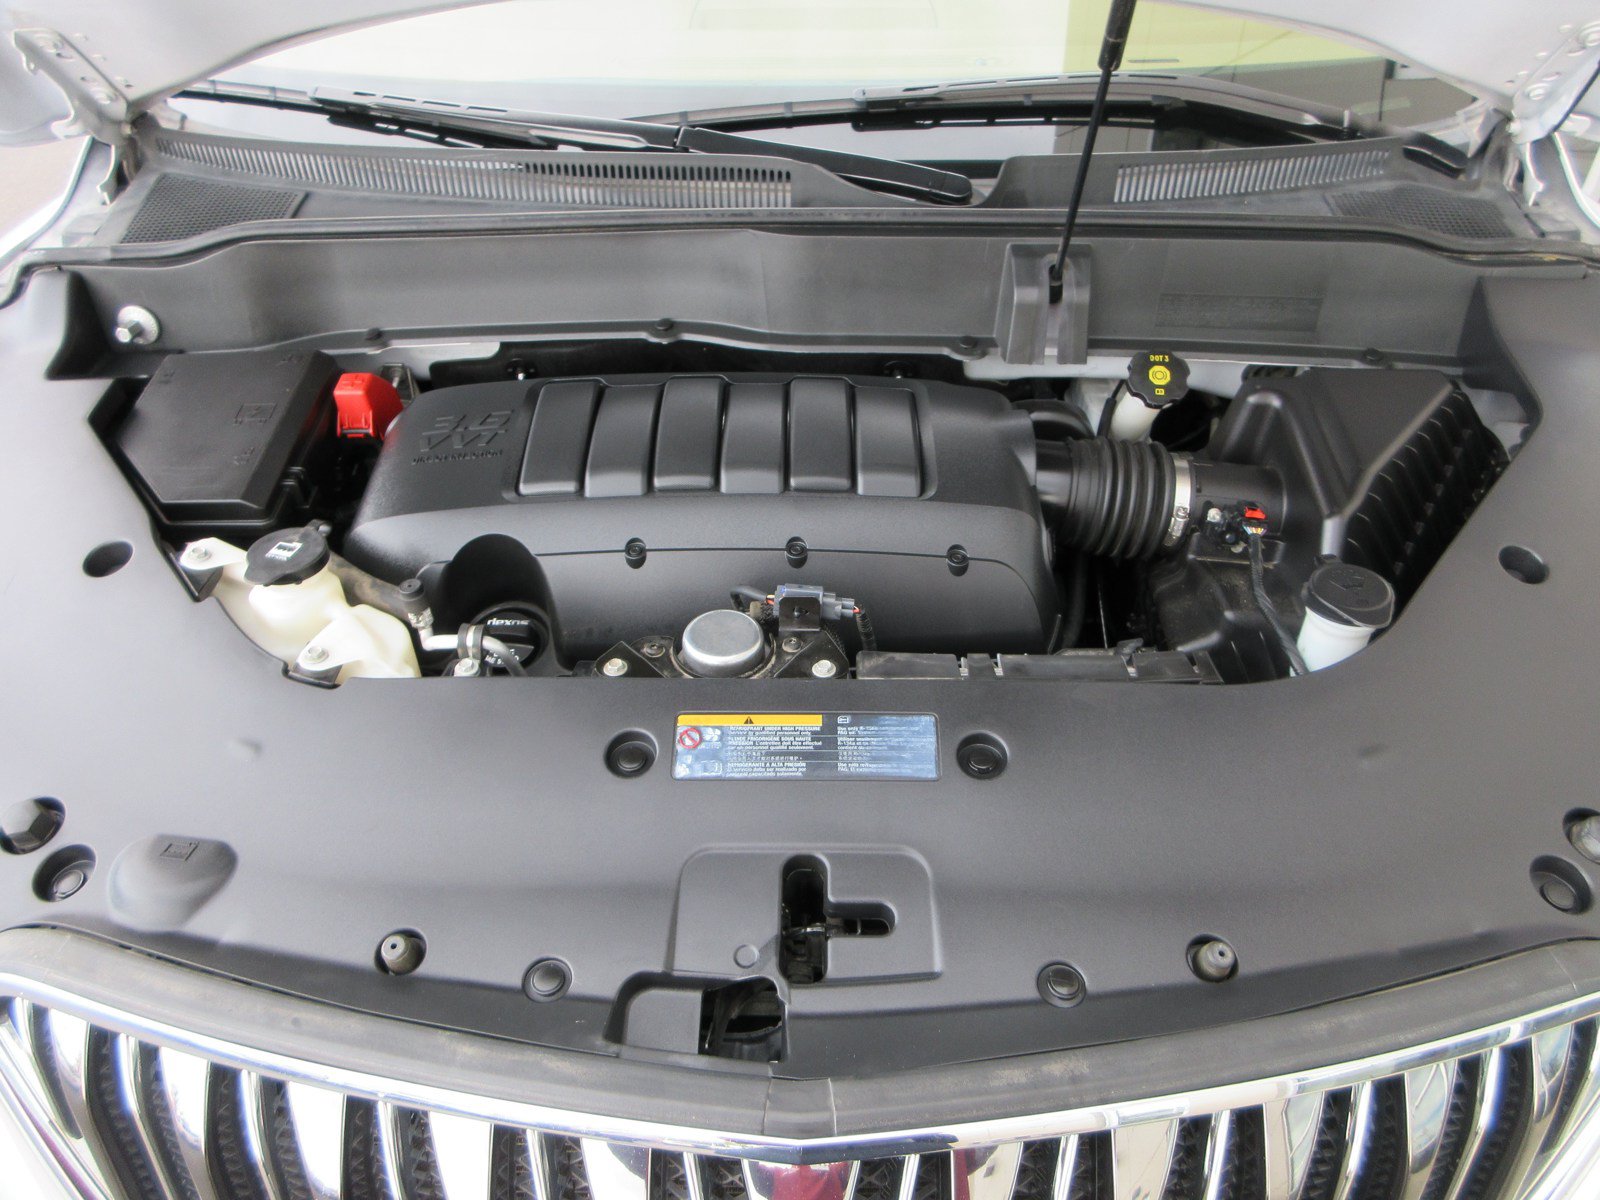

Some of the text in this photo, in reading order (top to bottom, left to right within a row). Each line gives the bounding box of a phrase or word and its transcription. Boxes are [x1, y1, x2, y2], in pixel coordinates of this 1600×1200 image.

[1149, 354, 1163, 362] DOT
[421, 409, 515, 435] 3.6
[419, 429, 508, 452] VVT
[410, 449, 504, 465] DIRECT INJECTION
